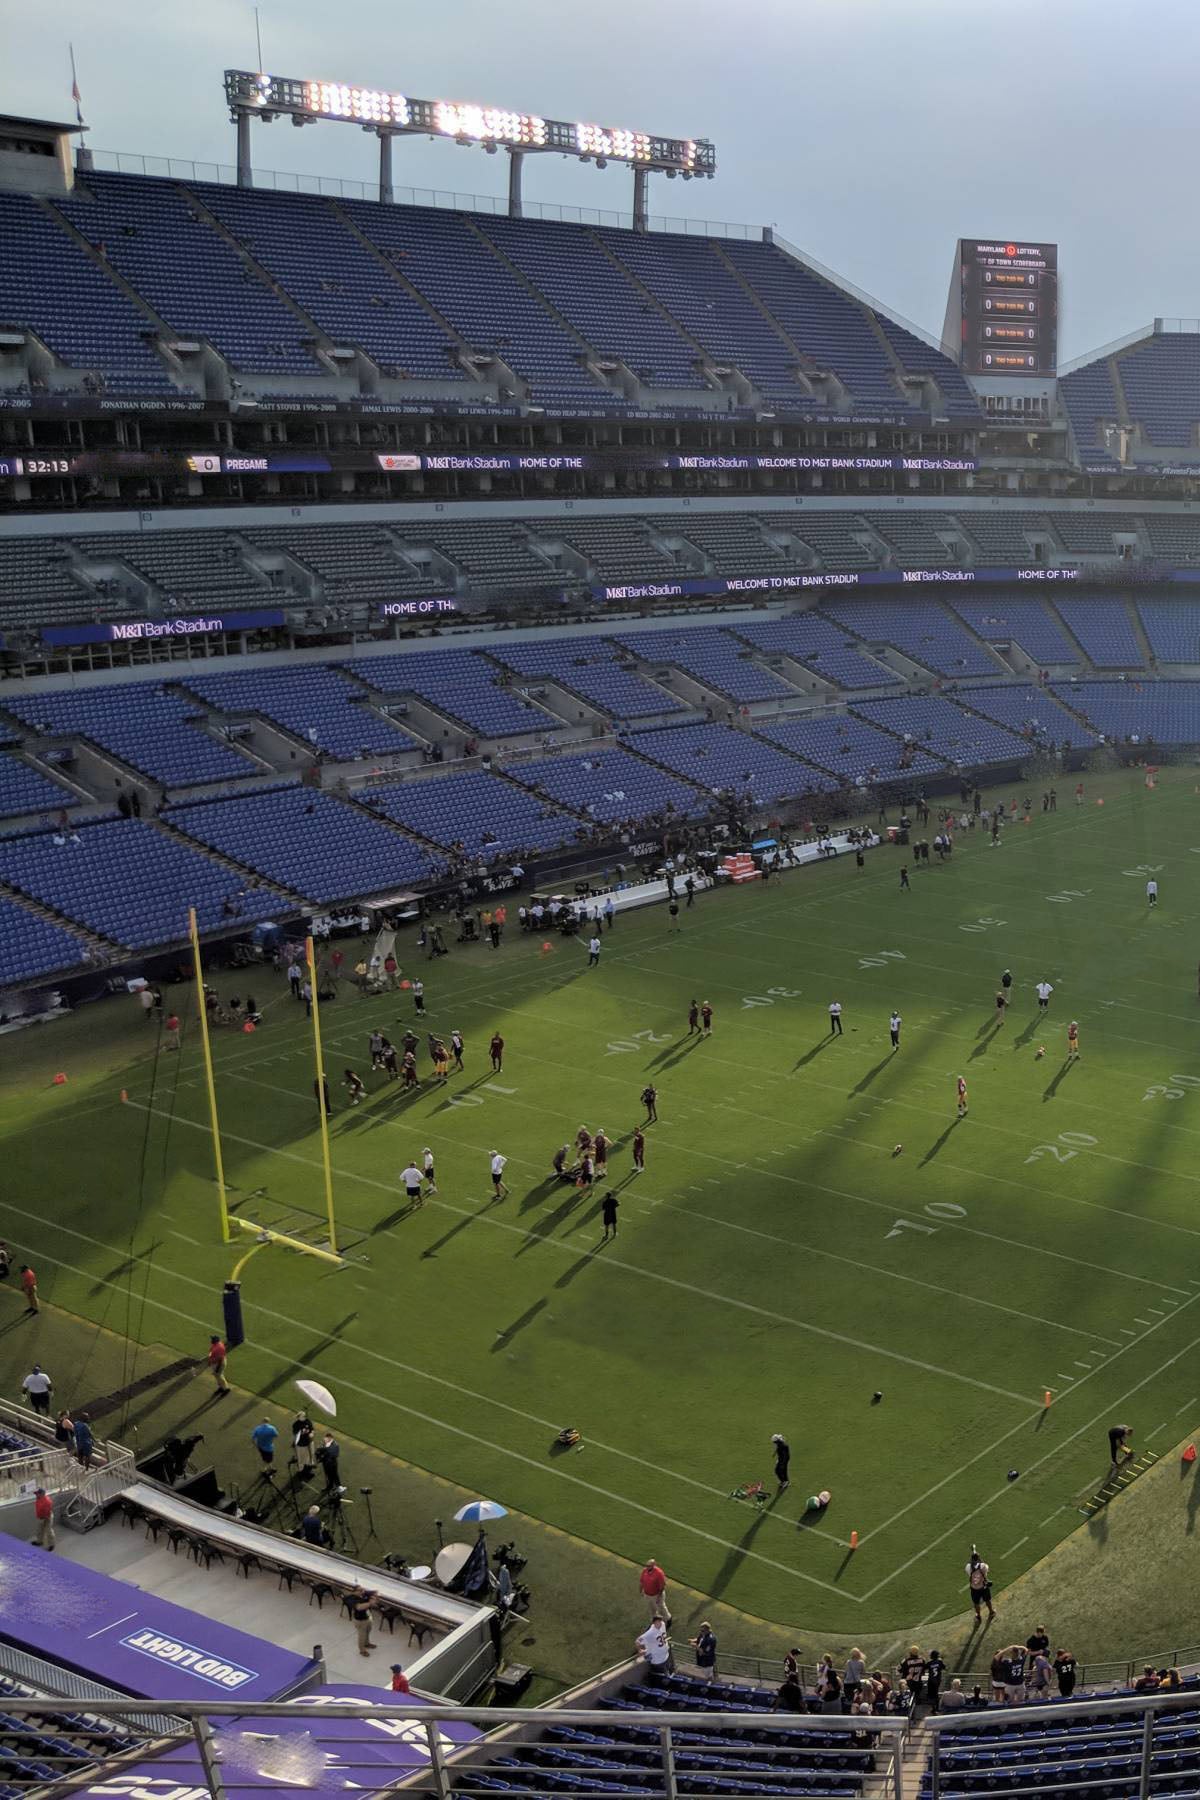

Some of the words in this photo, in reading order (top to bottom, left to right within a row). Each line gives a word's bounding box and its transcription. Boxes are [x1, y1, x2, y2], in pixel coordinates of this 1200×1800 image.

[986, 272, 991, 282] 0
[1029, 274, 1034, 284] 0
[986, 299, 991, 309] 0
[1029, 302, 1034, 311] 0
[986, 327, 991, 336] 0
[1029, 329, 1034, 338] 0
[986, 354, 991, 364] 0
[1029, 356, 1034, 366] 0
[100, 401, 139, 409] JONATHAN
[140, 401, 166, 409] OGDEN
[168, 402, 205, 410] 1996-2007
[28, 461, 68, 472] 32:13
[204, 459, 213, 470] 0
[226, 459, 268, 470] PREGAME
[427, 457, 451, 468] M&T
[451, 457, 473, 468] Bank
[473, 457, 511, 469] Stadium
[519, 458, 547, 468] HOME
[549, 458, 562, 468] OF
[564, 458, 582, 468] THE
[679, 457, 699, 467] M&T
[699, 457, 717, 467] Bank
[718, 457, 748, 468] Stadium
[757, 458, 797, 467] WELCOME
[799, 458, 810, 467] TO
[812, 458, 830, 467] M&T
[832, 458, 855, 467] BANK
[856, 458, 892, 468] STADIUM
[903, 459, 924, 469] M&T
[924, 459, 942, 469] Bank
[943, 460, 974, 470] Stadium
[903, 571, 922, 581] M&T
[922, 571, 941, 581] Bank
[942, 570, 975, 580] Stadium
[1018, 570, 1045, 579] HOME
[1046, 570, 1060, 579] OF
[1061, 570, 1076, 579] TH
[726, 579, 769, 590] WELCOME
[770, 578, 782, 587] TO
[783, 577, 801, 586] M&T
[802, 576, 825, 585] BANK
[825, 574, 858, 584] STADIUM
[606, 588, 628, 599] M&T
[628, 586, 648, 598] Bank
[648, 584, 681, 596] Stadium
[384, 602, 416, 615] HOME
[419, 601, 434, 612] OF
[436, 600, 455, 611] TH
[112, 623, 144, 640] M&T
[145, 621, 175, 637] Bank
[175, 619, 223, 633] Stadium
[959, 917, 1008, 932] 50
[858, 950, 907, 967] 40
[743, 986, 802, 1008] 30
[606, 1029, 672, 1053] 20
[448, 1083, 519, 1107] 10
[1031, 1131, 1099, 1163] 20
[893, 1202, 968, 1234] 10
